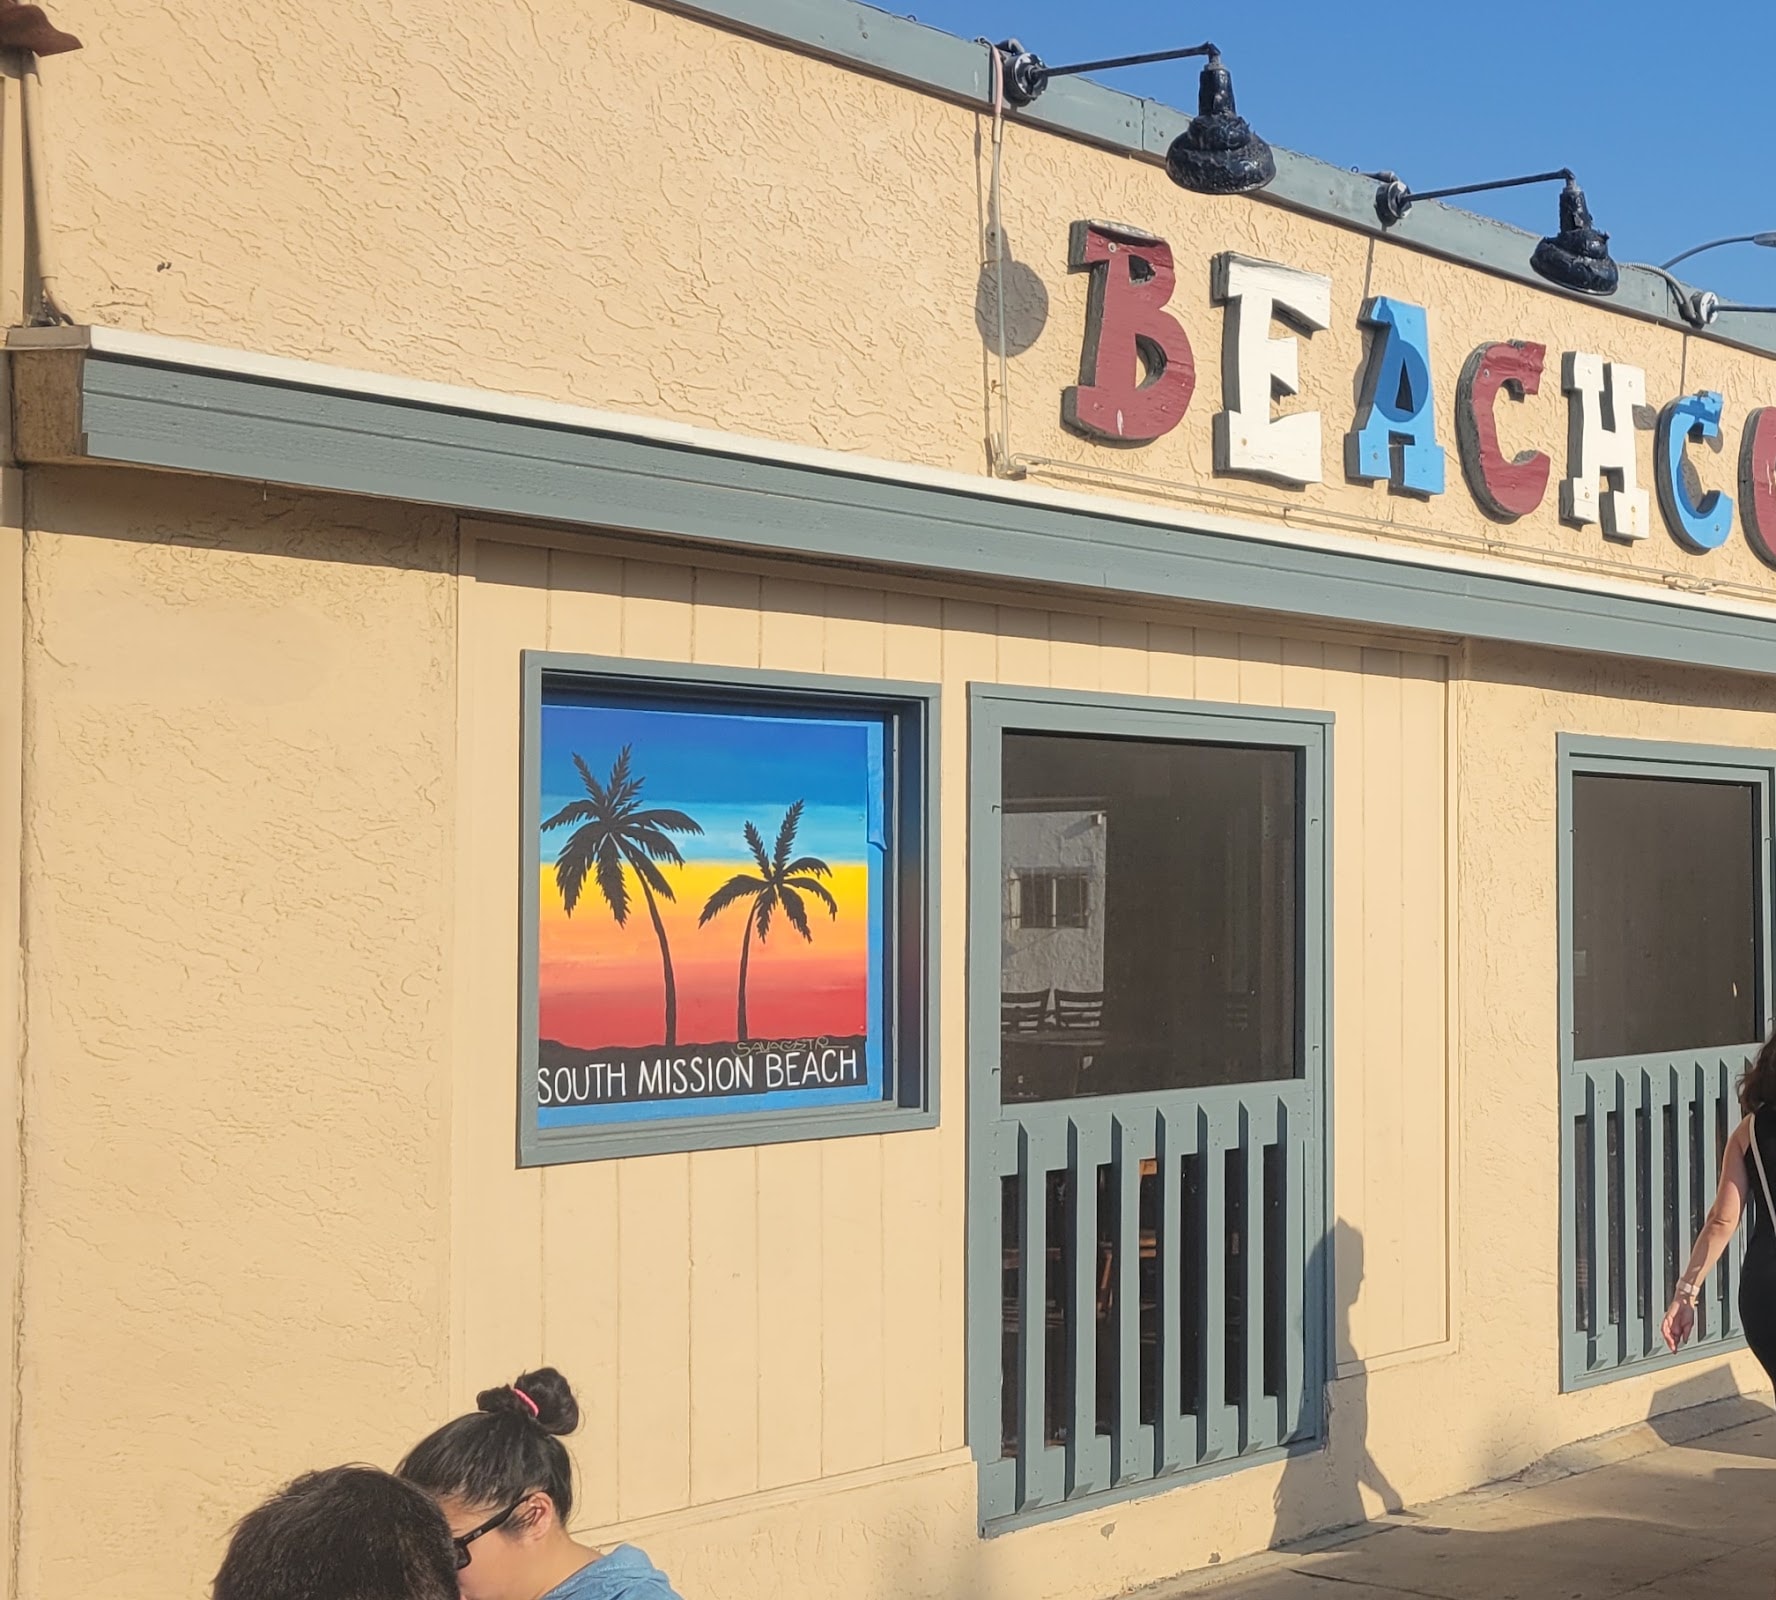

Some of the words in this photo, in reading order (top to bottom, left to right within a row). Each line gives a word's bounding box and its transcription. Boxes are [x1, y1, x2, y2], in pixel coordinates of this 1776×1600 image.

[538, 1064, 626, 1105] SOUTH
[638, 1055, 754, 1096] MISSION
[765, 1049, 857, 1089] BEACH
